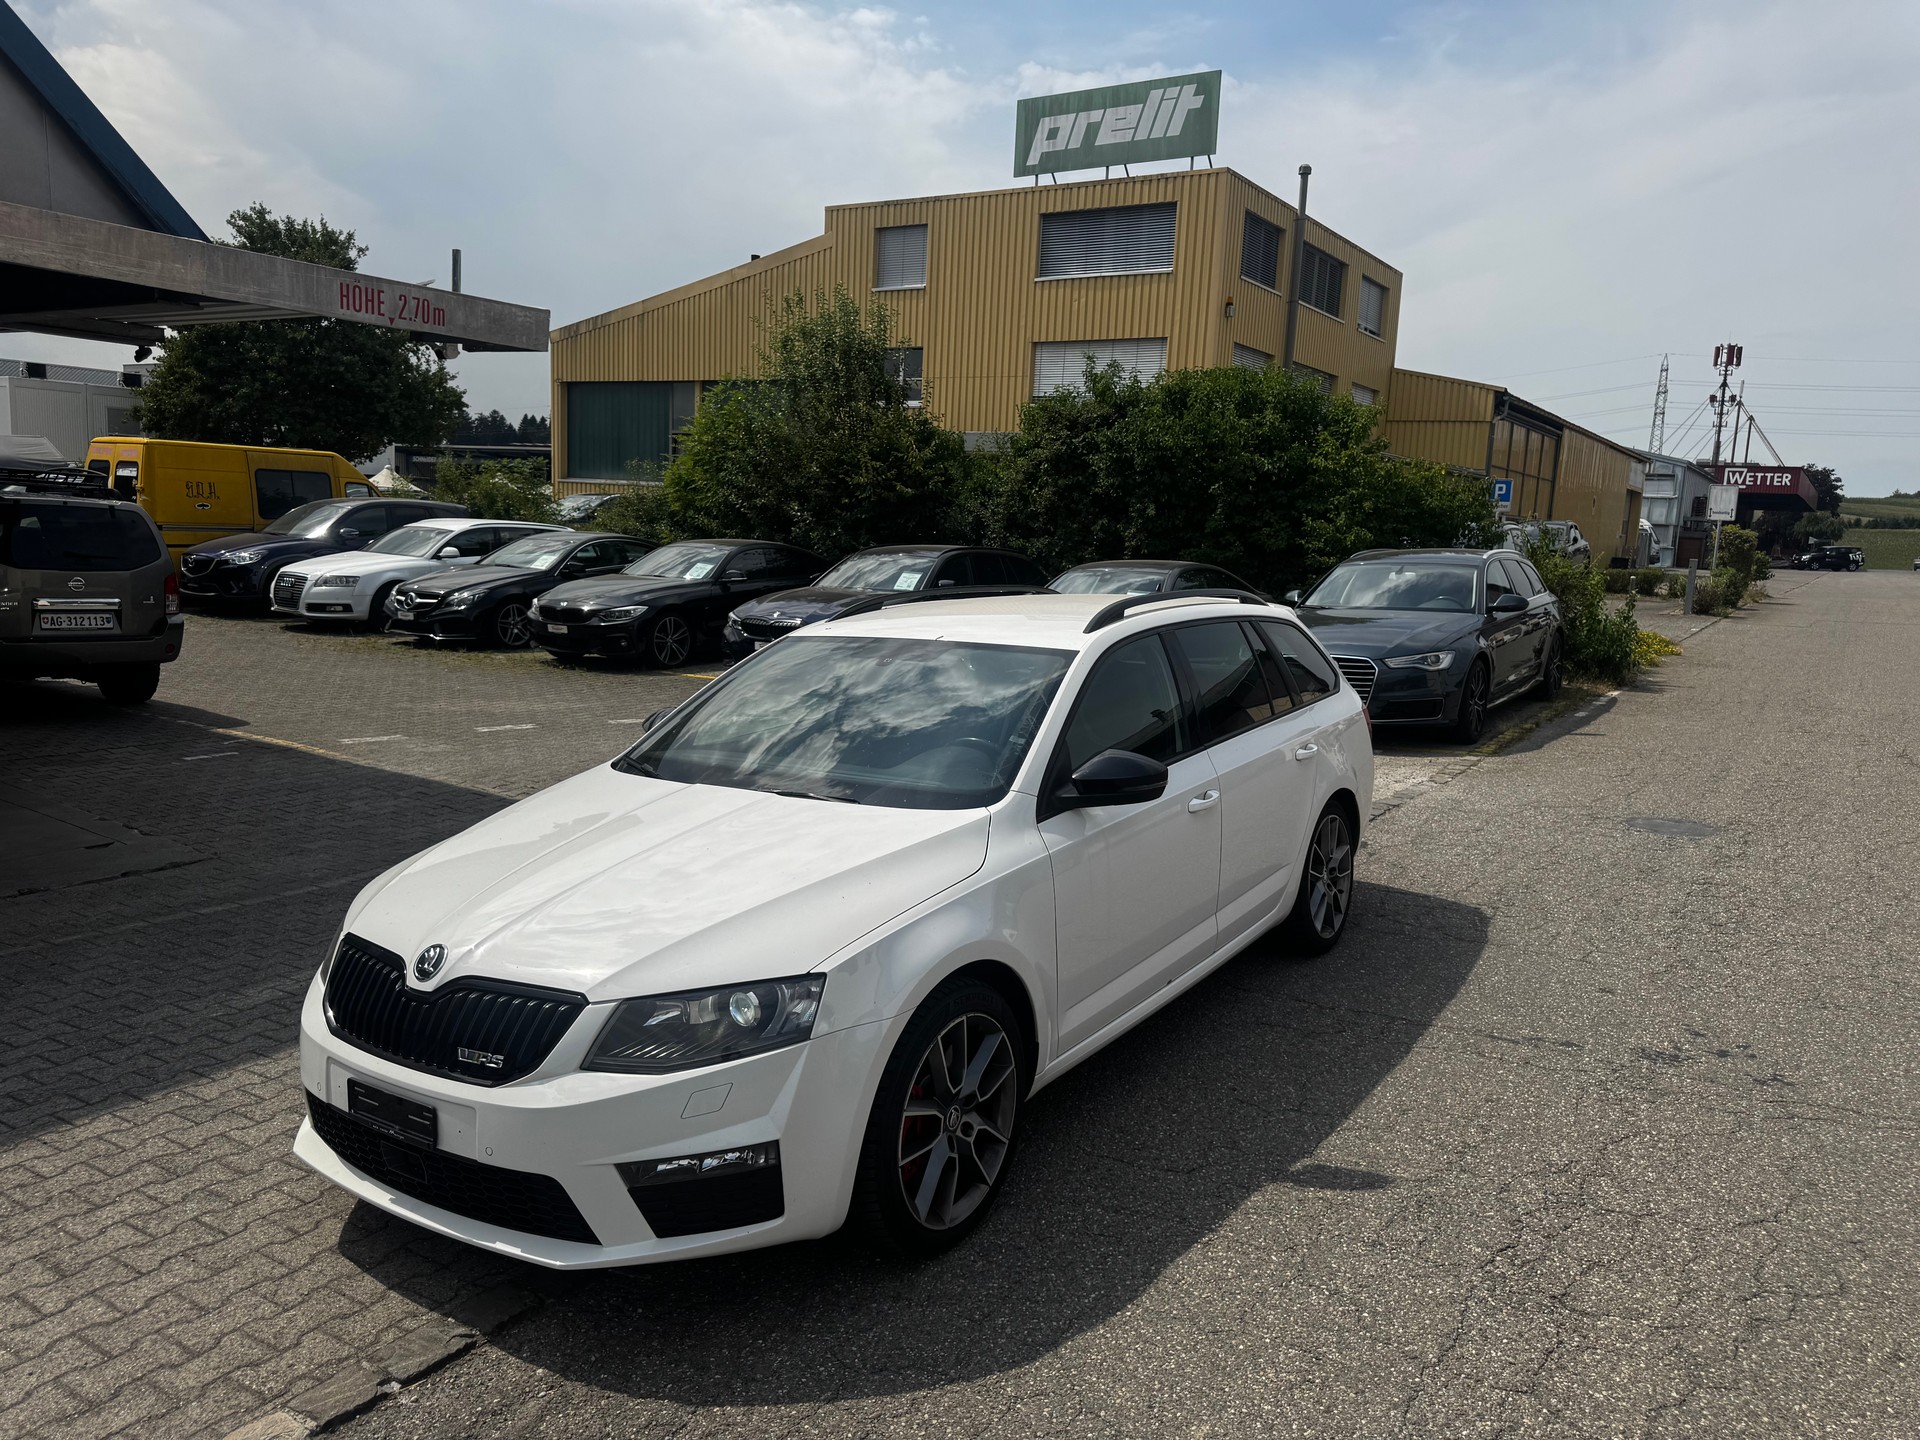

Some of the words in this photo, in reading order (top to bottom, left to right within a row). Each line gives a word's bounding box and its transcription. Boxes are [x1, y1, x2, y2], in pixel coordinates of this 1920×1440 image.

[1026, 84, 1204, 166] prelit
[340, 279, 385, 317] HÖHE
[1494, 483, 1507, 499] P
[1726, 468, 1792, 486] WETTER
